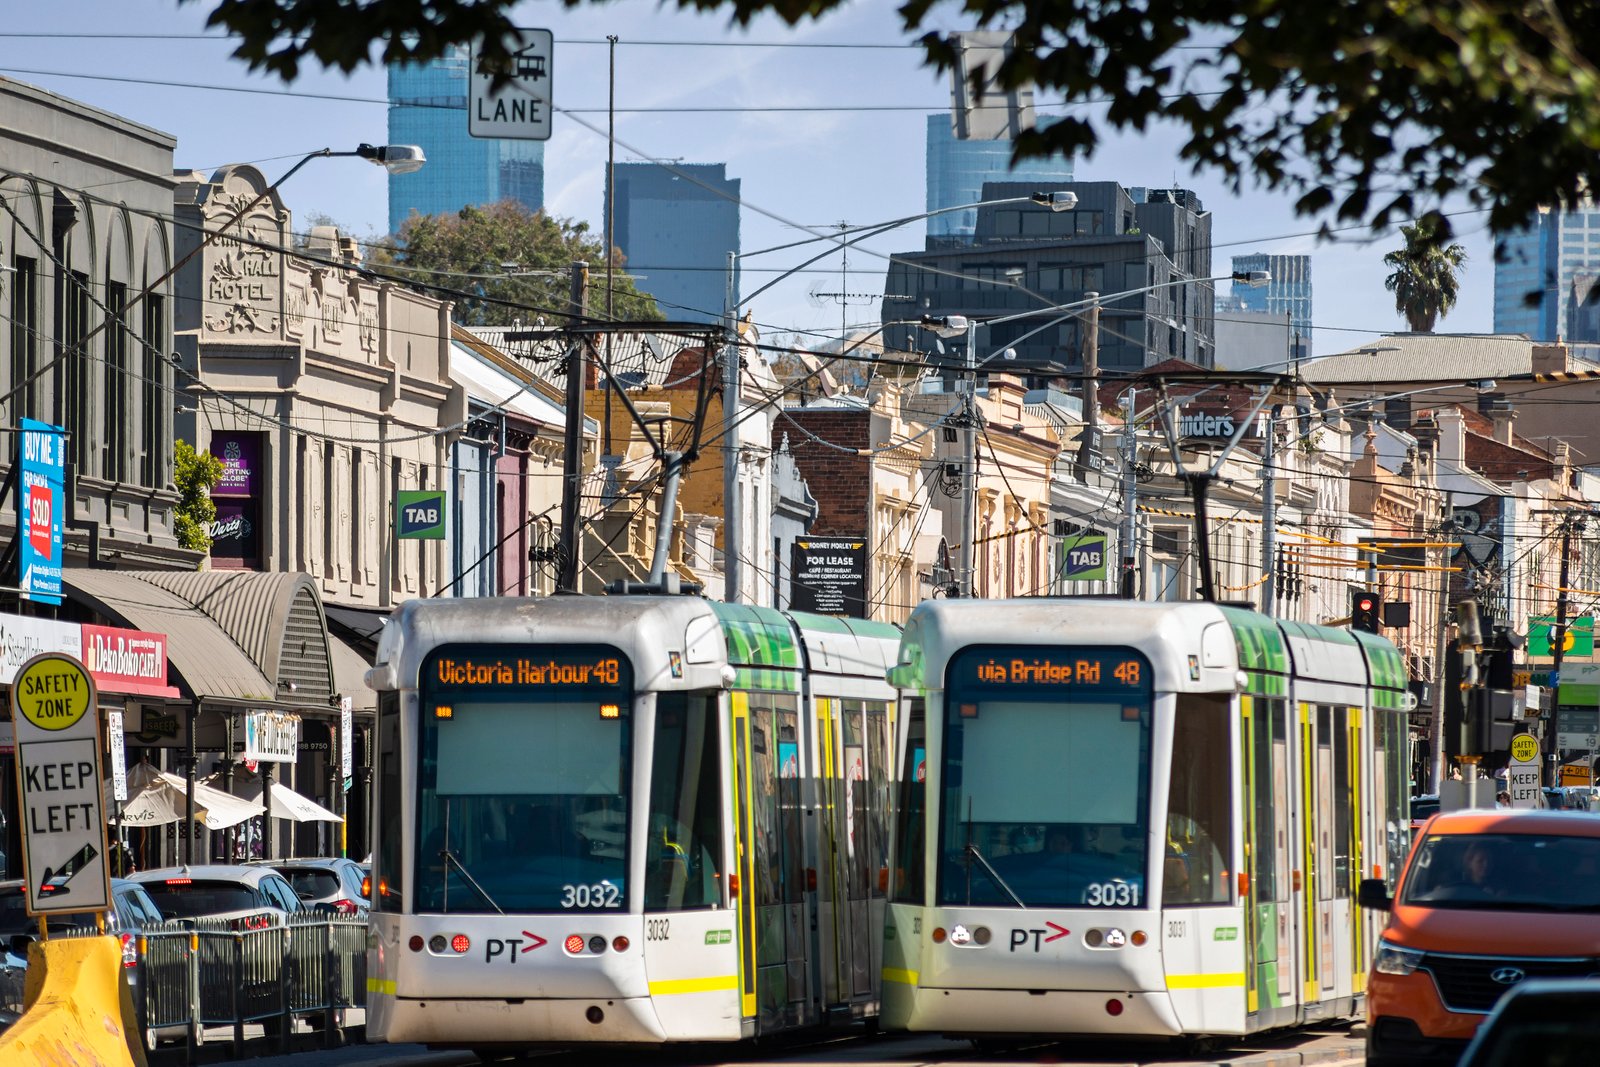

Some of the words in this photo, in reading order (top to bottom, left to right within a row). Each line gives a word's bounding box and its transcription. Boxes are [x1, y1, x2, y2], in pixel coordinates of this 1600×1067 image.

[478, 97, 542, 123] LANE
[243, 260, 279, 277] HALL
[209, 282, 273, 301] HOTEL
[25, 431, 40, 462] BUY
[32, 496, 50, 527] SOLD
[405, 508, 438, 524] TAB
[808, 542, 830, 550] RODNEY
[806, 557, 825, 566] FOR
[826, 557, 854, 566] LEASE
[1070, 551, 1101, 566] TAB
[438, 659, 513, 685] Victoria
[517, 659, 594, 685] Harbour
[593, 659, 619, 684] 48
[977, 658, 1006, 682] via
[1010, 658, 1072, 684] Bridge
[1075, 659, 1101, 684] Rd
[1113, 660, 1141, 685] 48
[25, 673, 80, 695] SAFETY
[36, 698, 74, 719] ZONE
[1513, 740, 1535, 749] SAFETY
[25, 761, 94, 793] KEEP
[1512, 773, 1538, 785] KEEP
[1513, 789, 1538, 800] LEFT
[30, 803, 95, 835] LEFT
[560, 884, 621, 909] 3032
[1087, 883, 1139, 907] 3031
[647, 919, 670, 942] 3032
[1010, 928, 1048, 953] PT
[1167, 920, 1187, 939] 3031
[486, 938, 524, 964] PT
